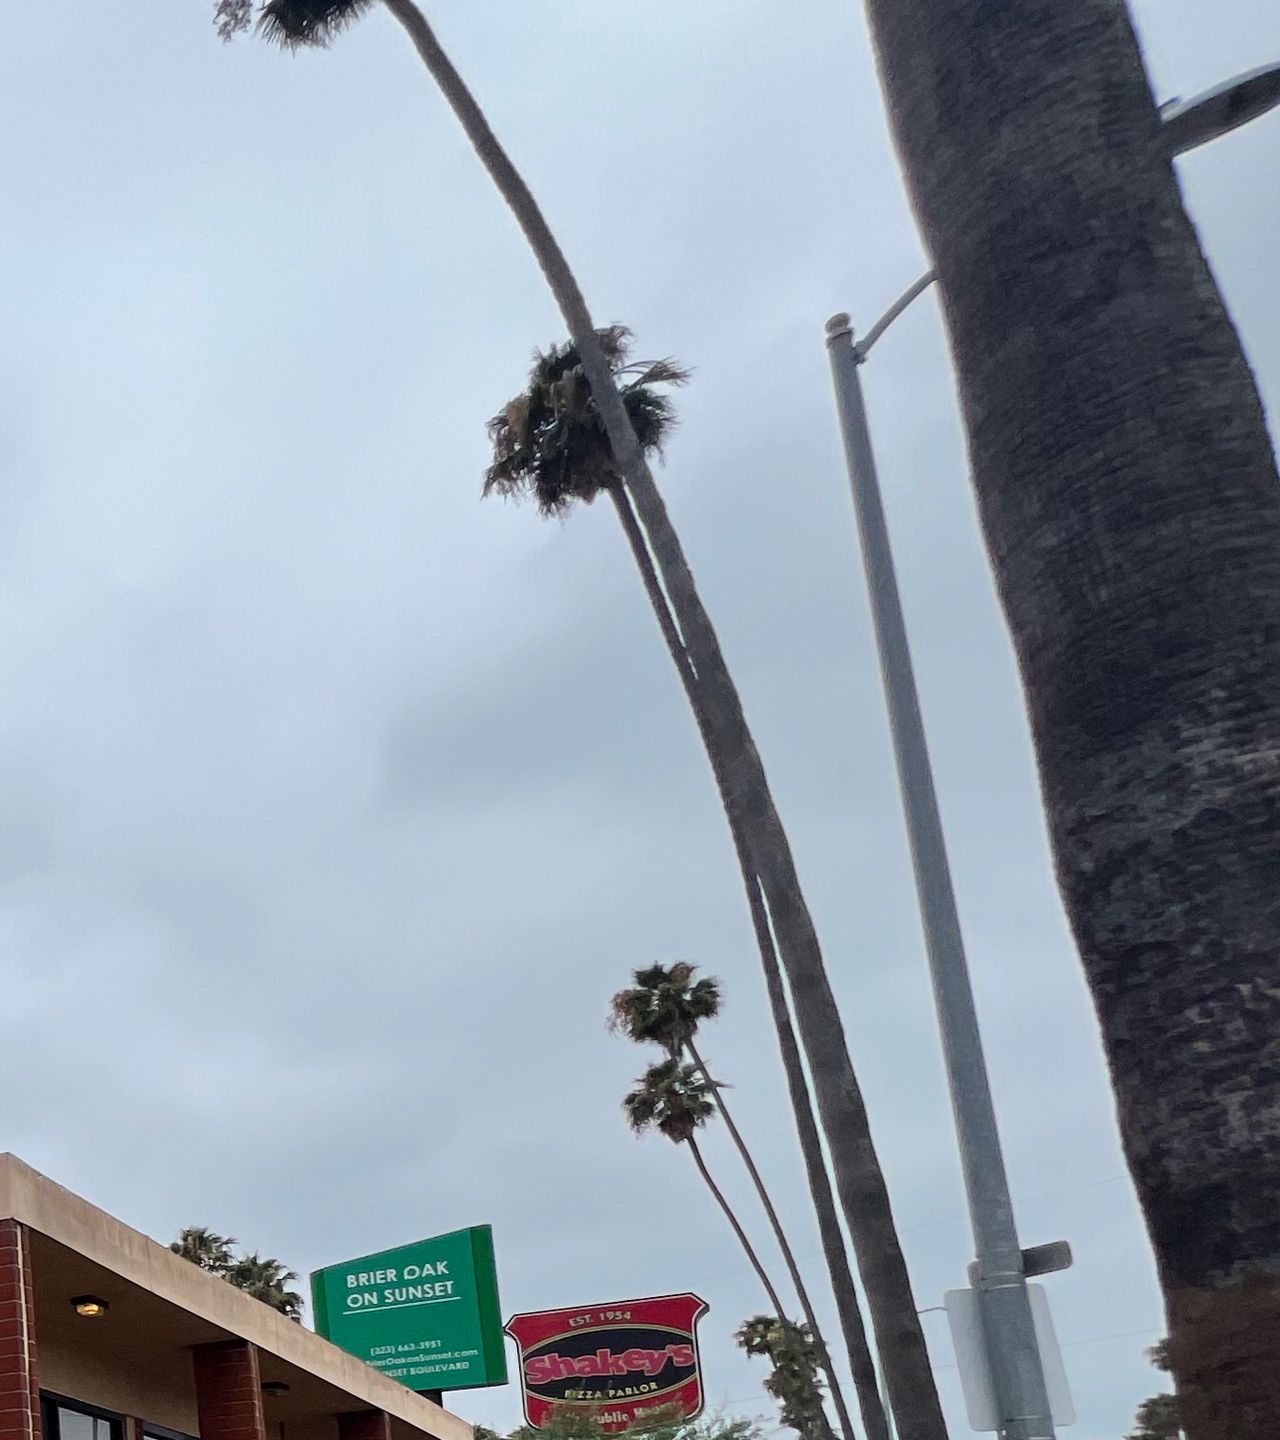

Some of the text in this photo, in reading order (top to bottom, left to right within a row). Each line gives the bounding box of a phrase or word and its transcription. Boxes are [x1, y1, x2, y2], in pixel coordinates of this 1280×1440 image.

[346, 1261, 449, 1288] BRIER OAK
[346, 1281, 454, 1308] ON SUNSET
[600, 1310, 632, 1322] 1954
[410, 1361, 469, 1375] BOULEVARD
[525, 1344, 695, 1385] Shakey's
[608, 1382, 659, 1399] PARLOR
